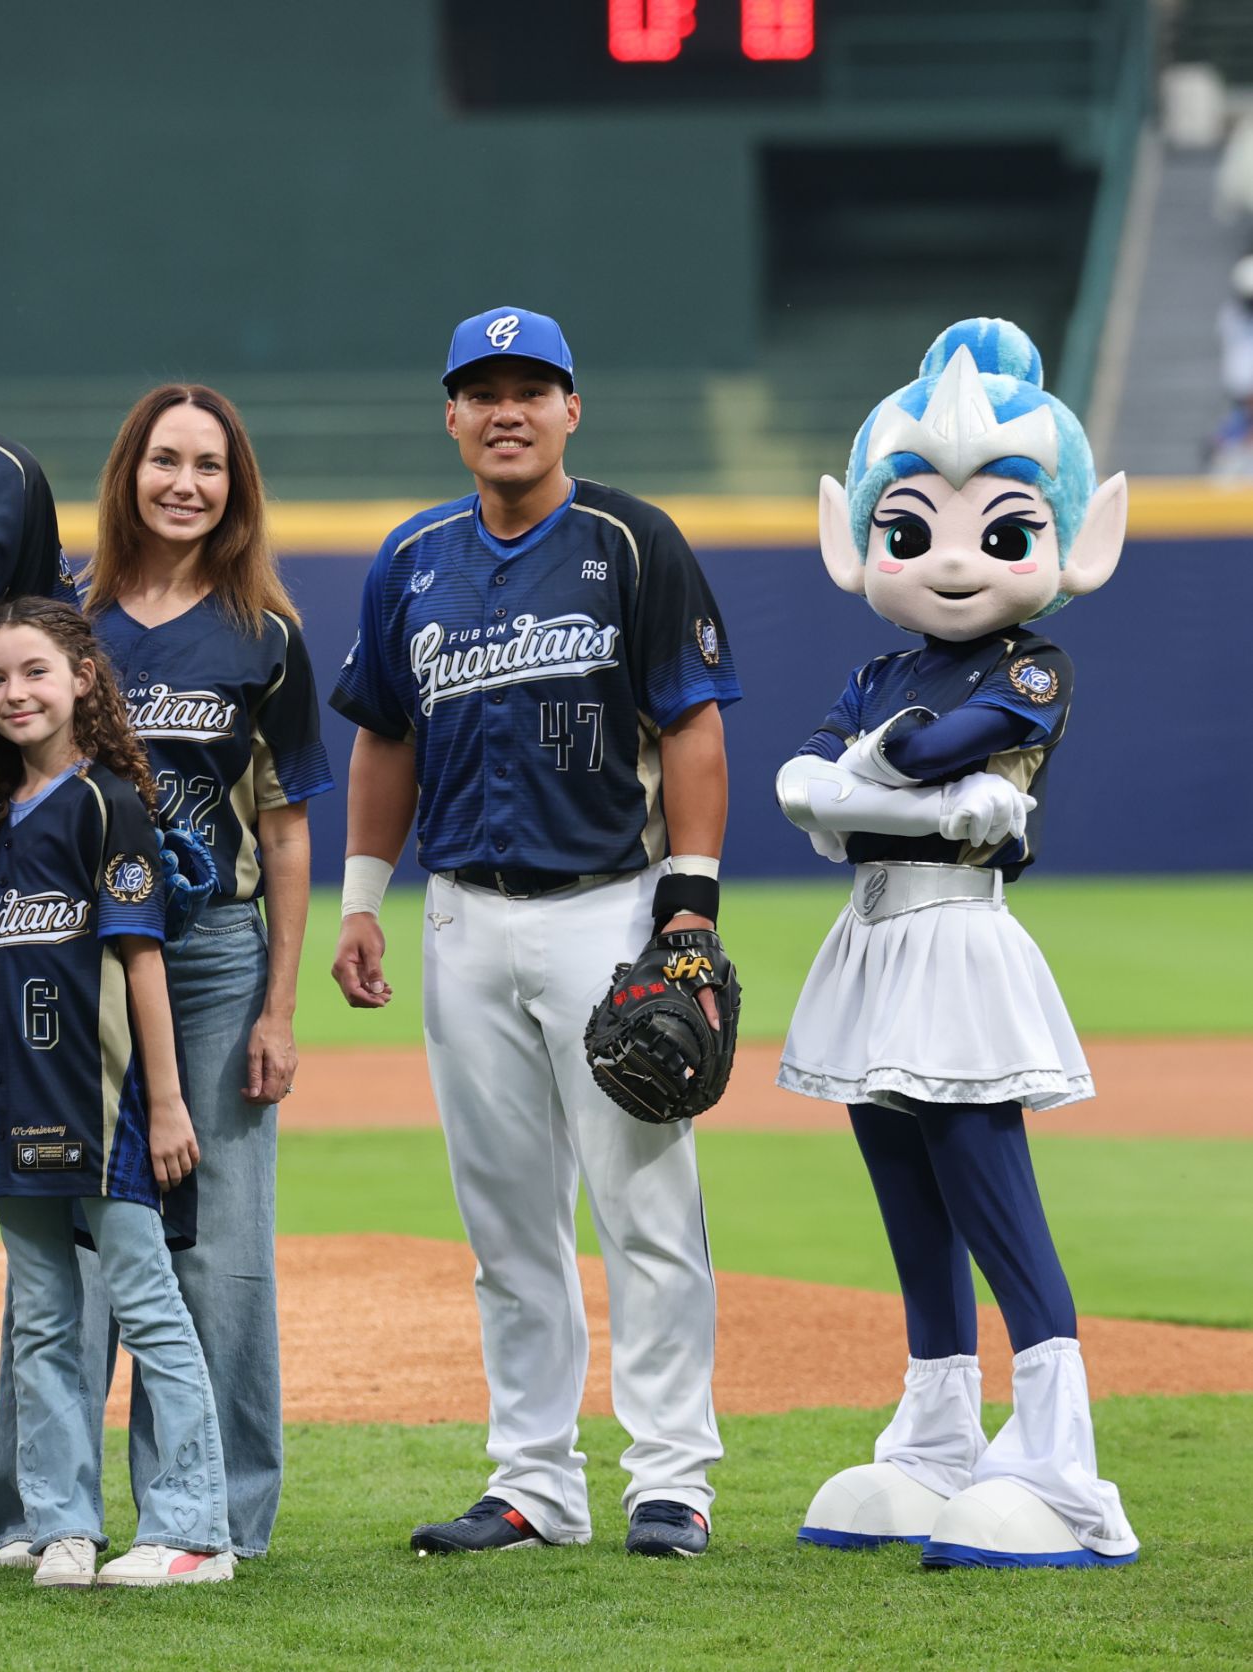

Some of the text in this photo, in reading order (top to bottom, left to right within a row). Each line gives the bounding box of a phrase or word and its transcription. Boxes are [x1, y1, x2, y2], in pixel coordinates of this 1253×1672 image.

[485, 314, 521, 352] G
[410, 613, 620, 717] Guardians
[448, 623, 506, 645] FUBON
[125, 683, 239, 744] rdians
[539, 701, 604, 772] 47
[156, 770, 224, 847] 22
[23, 978, 60, 1051] 6
